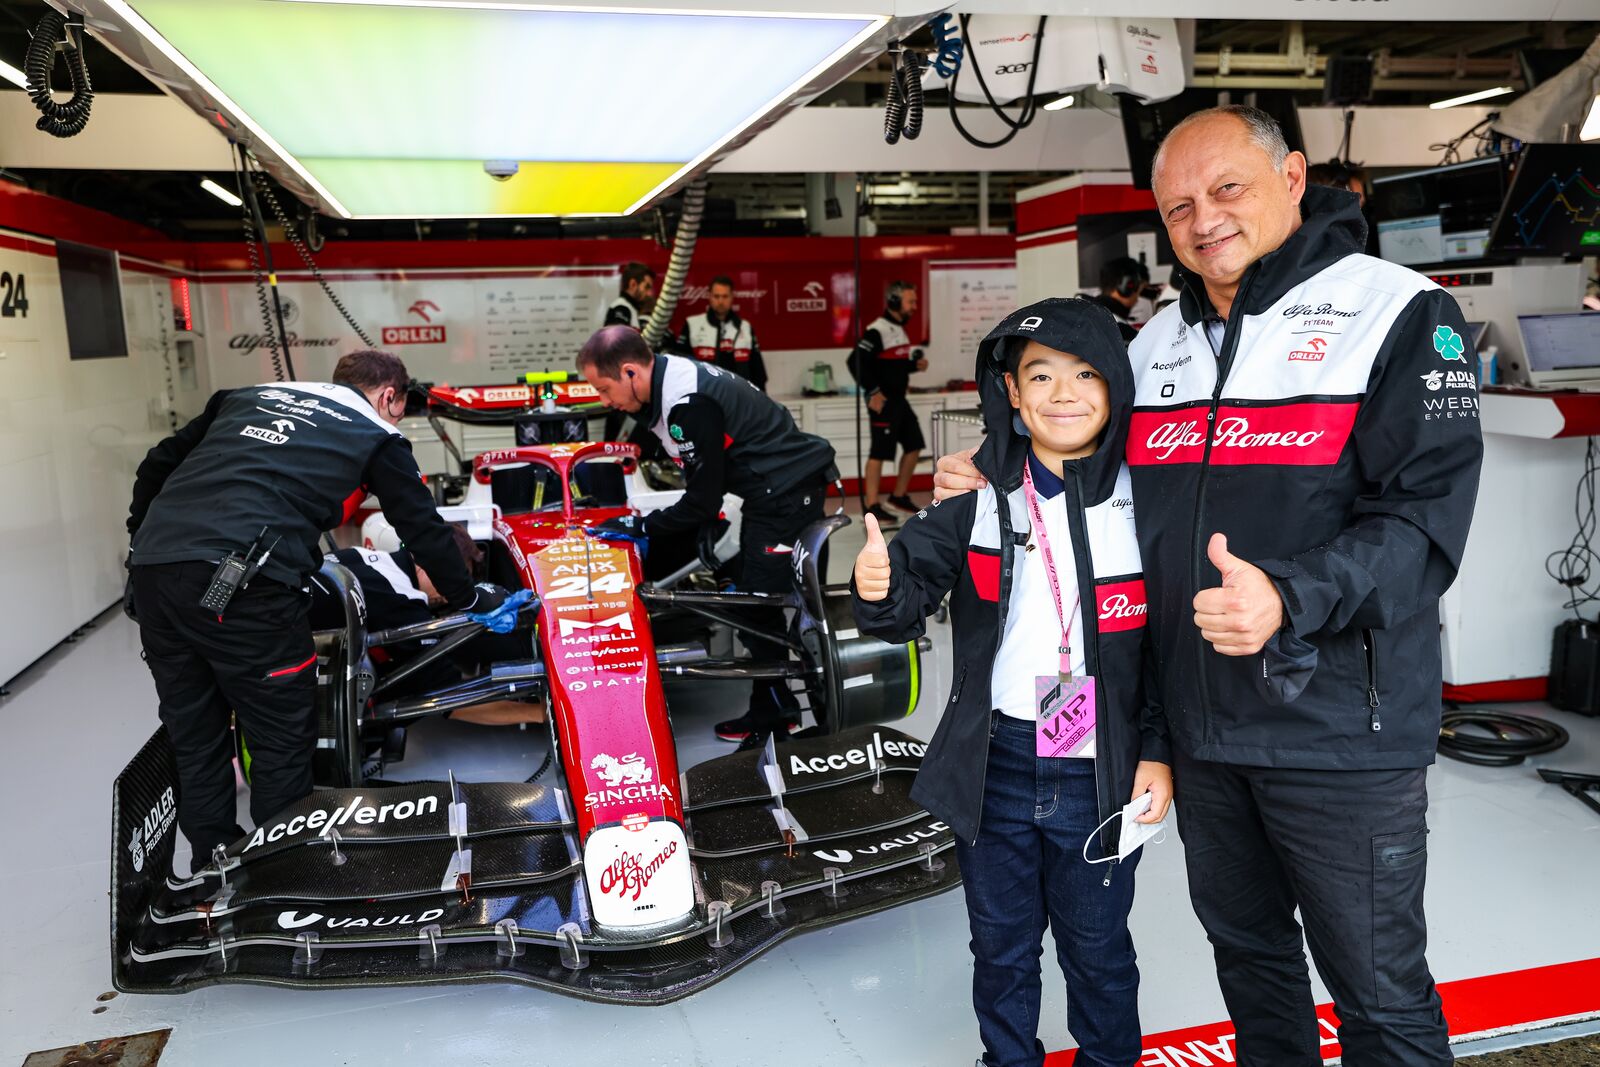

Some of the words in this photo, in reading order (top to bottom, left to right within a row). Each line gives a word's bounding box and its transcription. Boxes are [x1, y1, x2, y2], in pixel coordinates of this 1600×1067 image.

[995, 62, 1034, 75] acer
[1, 272, 28, 318] 24
[789, 301, 825, 311] ORLEN
[1283, 304, 1313, 319] Alfa
[1314, 303, 1363, 318] Romeo
[385, 329, 443, 343] ORLEN
[1289, 352, 1324, 361] ORLEN
[245, 428, 285, 444] ORLEN
[1146, 420, 1207, 460] Alfa
[1211, 417, 1324, 448] Romeo
[491, 451, 517, 461] PATH
[544, 572, 632, 600] 24
[1099, 594, 1147, 620] Rom
[561, 632, 636, 646] MARELLI
[564, 646, 640, 659] Accelleron
[581, 661, 643, 673] EVERDOME
[592, 676, 648, 689] PATH
[1042, 694, 1086, 740] VIP
[584, 784, 672, 807] SINGHA
[585, 796, 674, 812] CORPORATION
[144, 786, 175, 843] ADLER
[242, 795, 438, 853] Accelleron
[600, 851, 638, 898] Alfa
[626, 841, 677, 901] Romeo
[326, 908, 444, 928] VAULD
